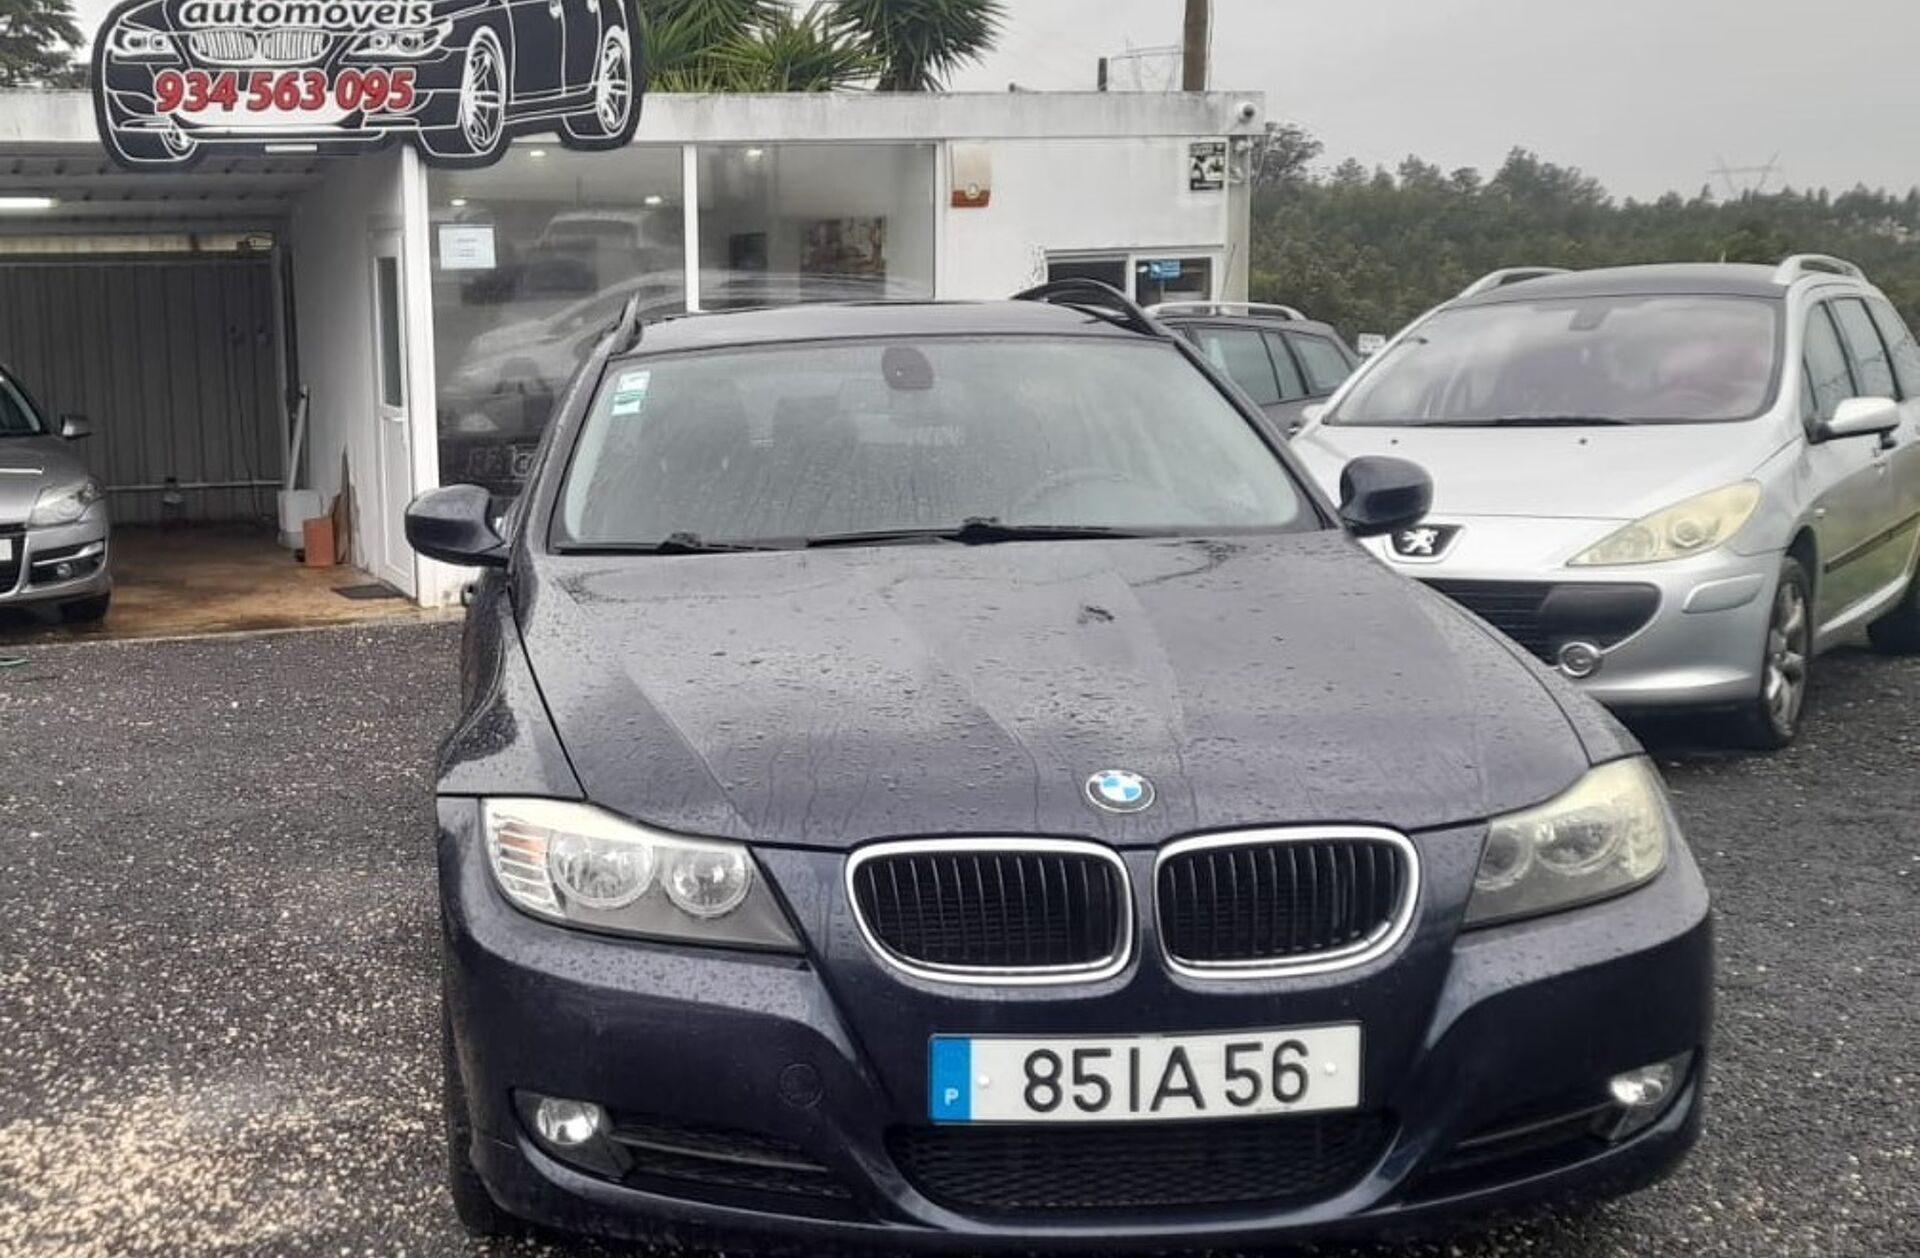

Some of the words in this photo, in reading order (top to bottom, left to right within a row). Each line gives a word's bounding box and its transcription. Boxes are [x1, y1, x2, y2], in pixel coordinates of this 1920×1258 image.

[155, 70, 239, 112] 934
[246, 70, 328, 111] 563
[335, 70, 416, 111] 095
[1224, 1039, 1310, 1107] 56
[944, 1088, 959, 1106] P
